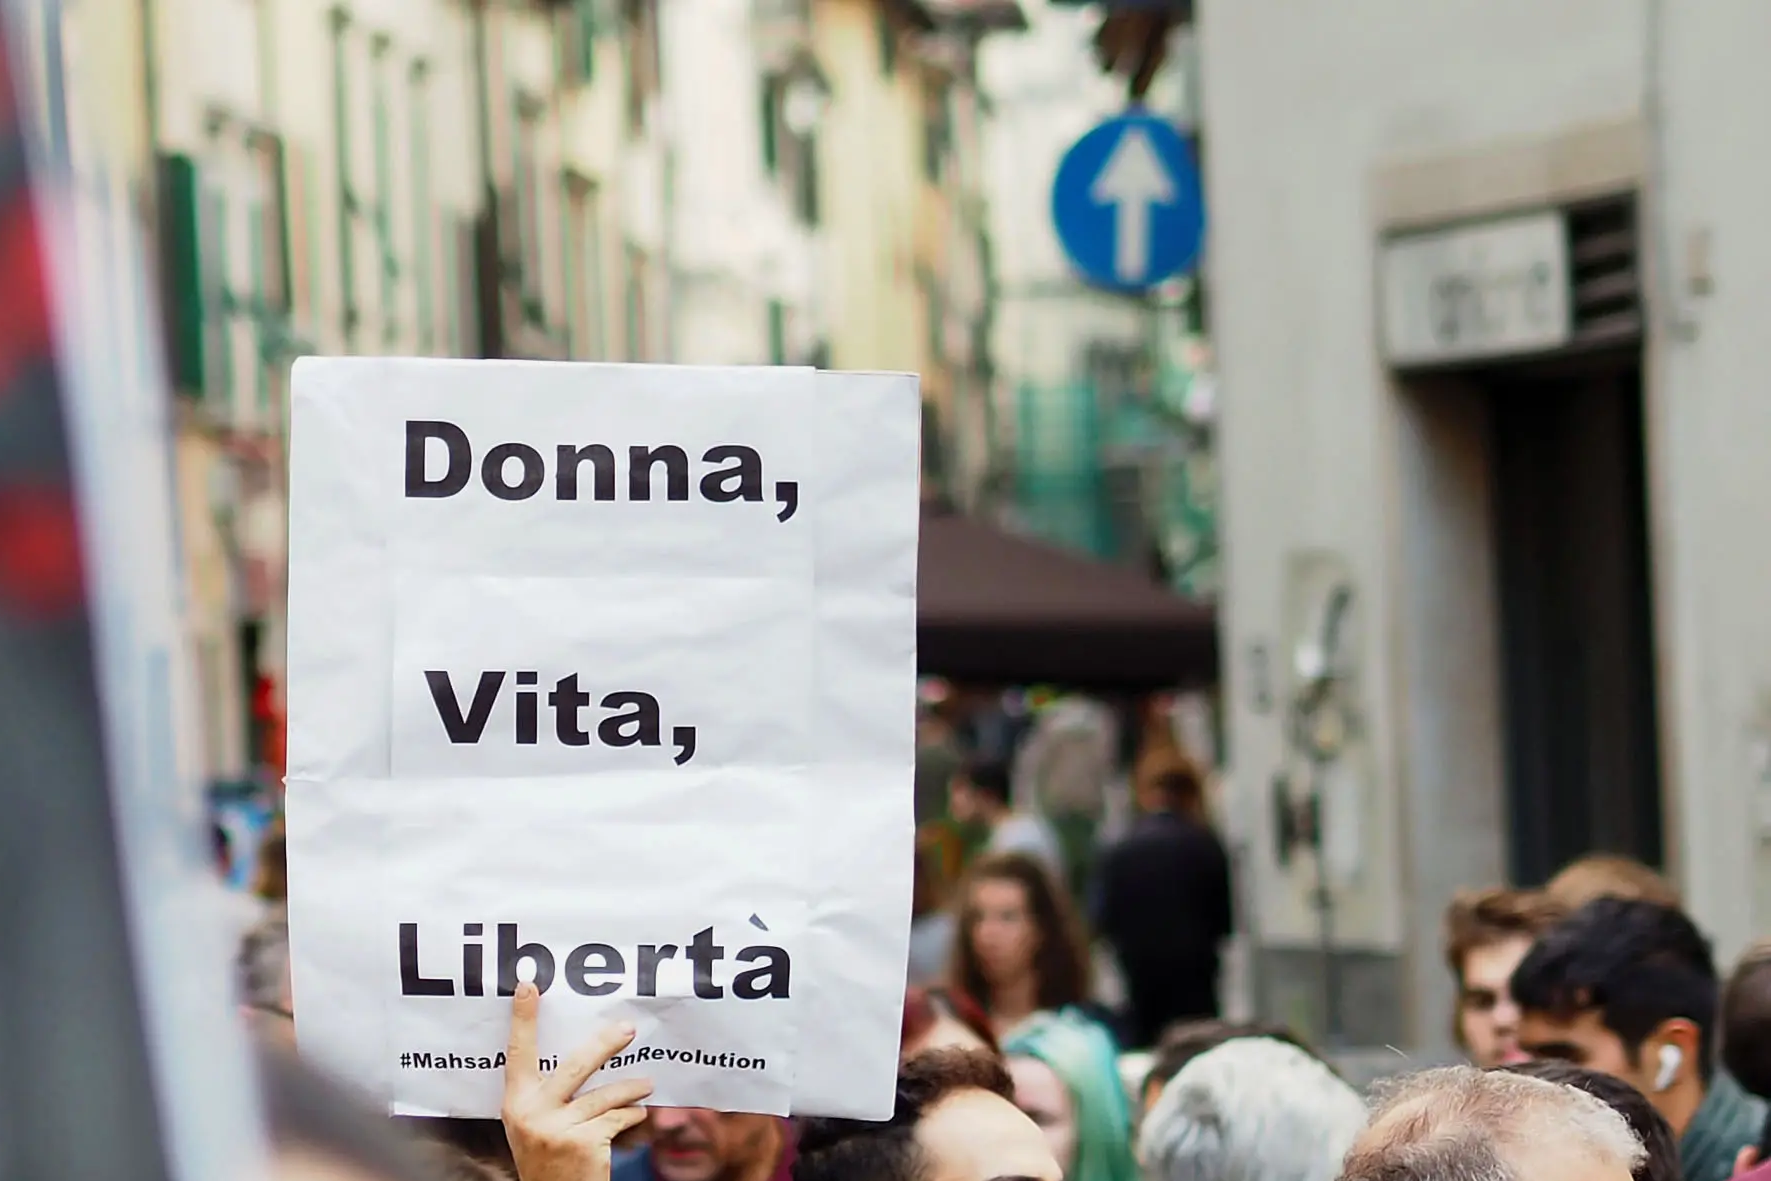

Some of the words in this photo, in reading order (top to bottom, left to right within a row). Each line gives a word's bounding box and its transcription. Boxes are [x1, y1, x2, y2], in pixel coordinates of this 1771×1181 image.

[405, 420, 799, 522] Donna,
[424, 670, 696, 765] Vita,
[399, 913, 790, 999] Libertà
[399, 1051, 559, 1072] #MahsaAni
